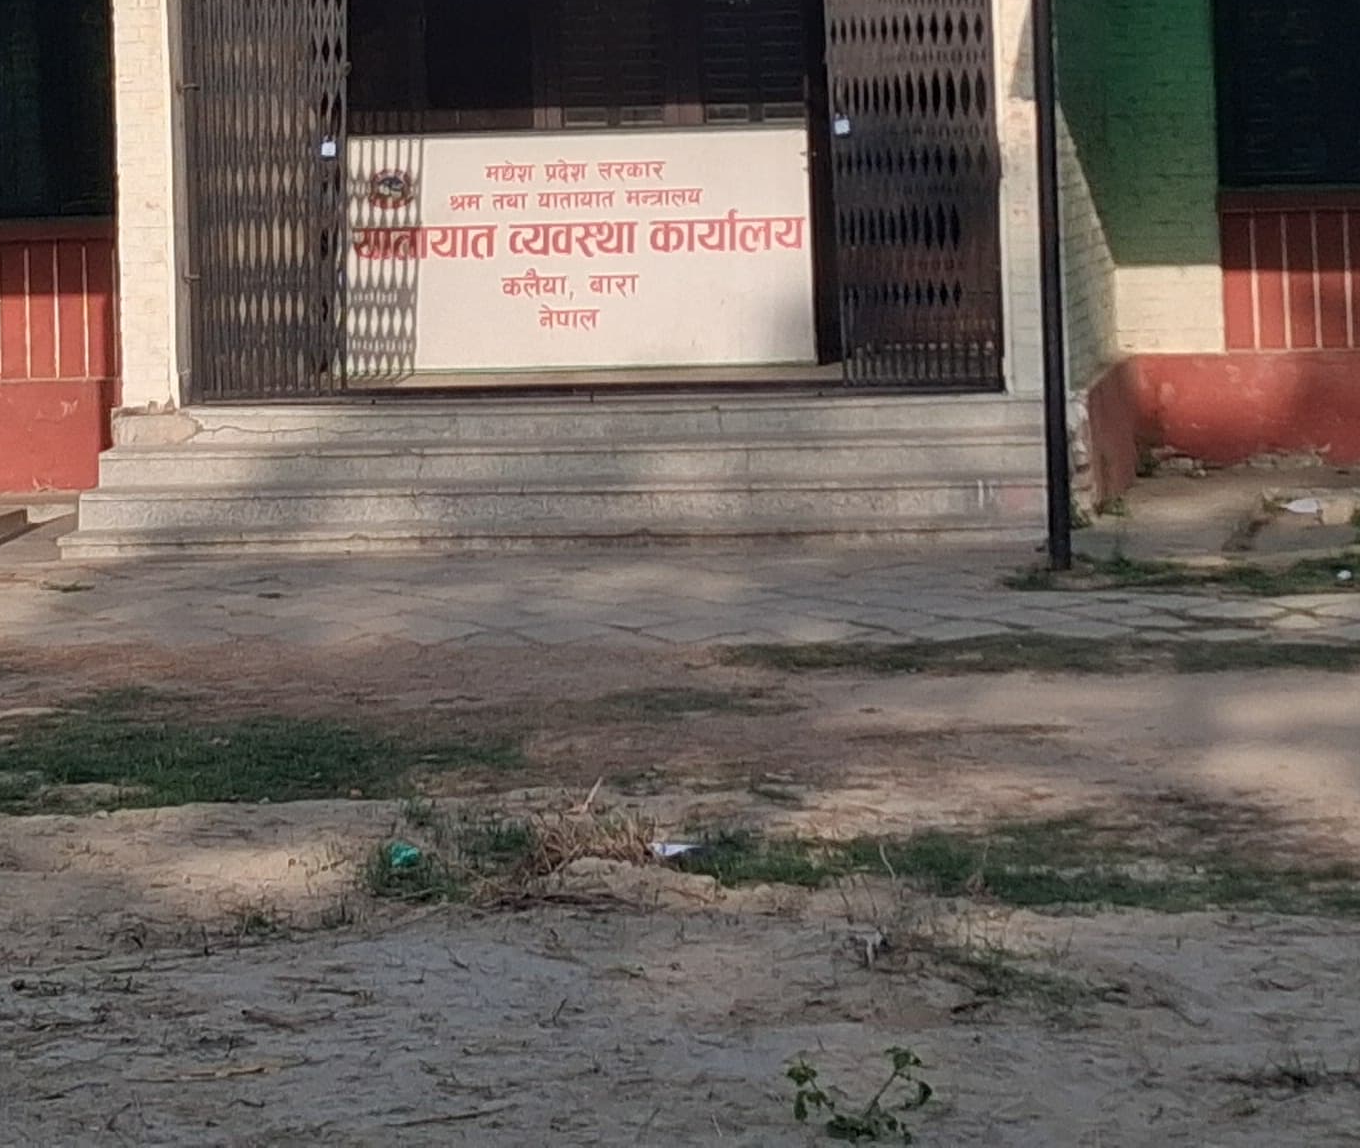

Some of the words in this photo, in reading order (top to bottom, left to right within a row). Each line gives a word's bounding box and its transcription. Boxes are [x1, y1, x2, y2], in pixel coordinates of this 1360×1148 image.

[545, 159, 587, 182] प्रदेश
[450, 194, 482, 211] श्रम
[537, 190, 615, 209] यातायात
[625, 188, 702, 207] मन्त्रालय
[509, 220, 637, 257] व्यवस्था
[649, 209, 805, 254] कार्यालय
[501, 268, 574, 300] कलैया,
[589, 274, 639, 297] बारा
[539, 304, 600, 330] नेपाल
